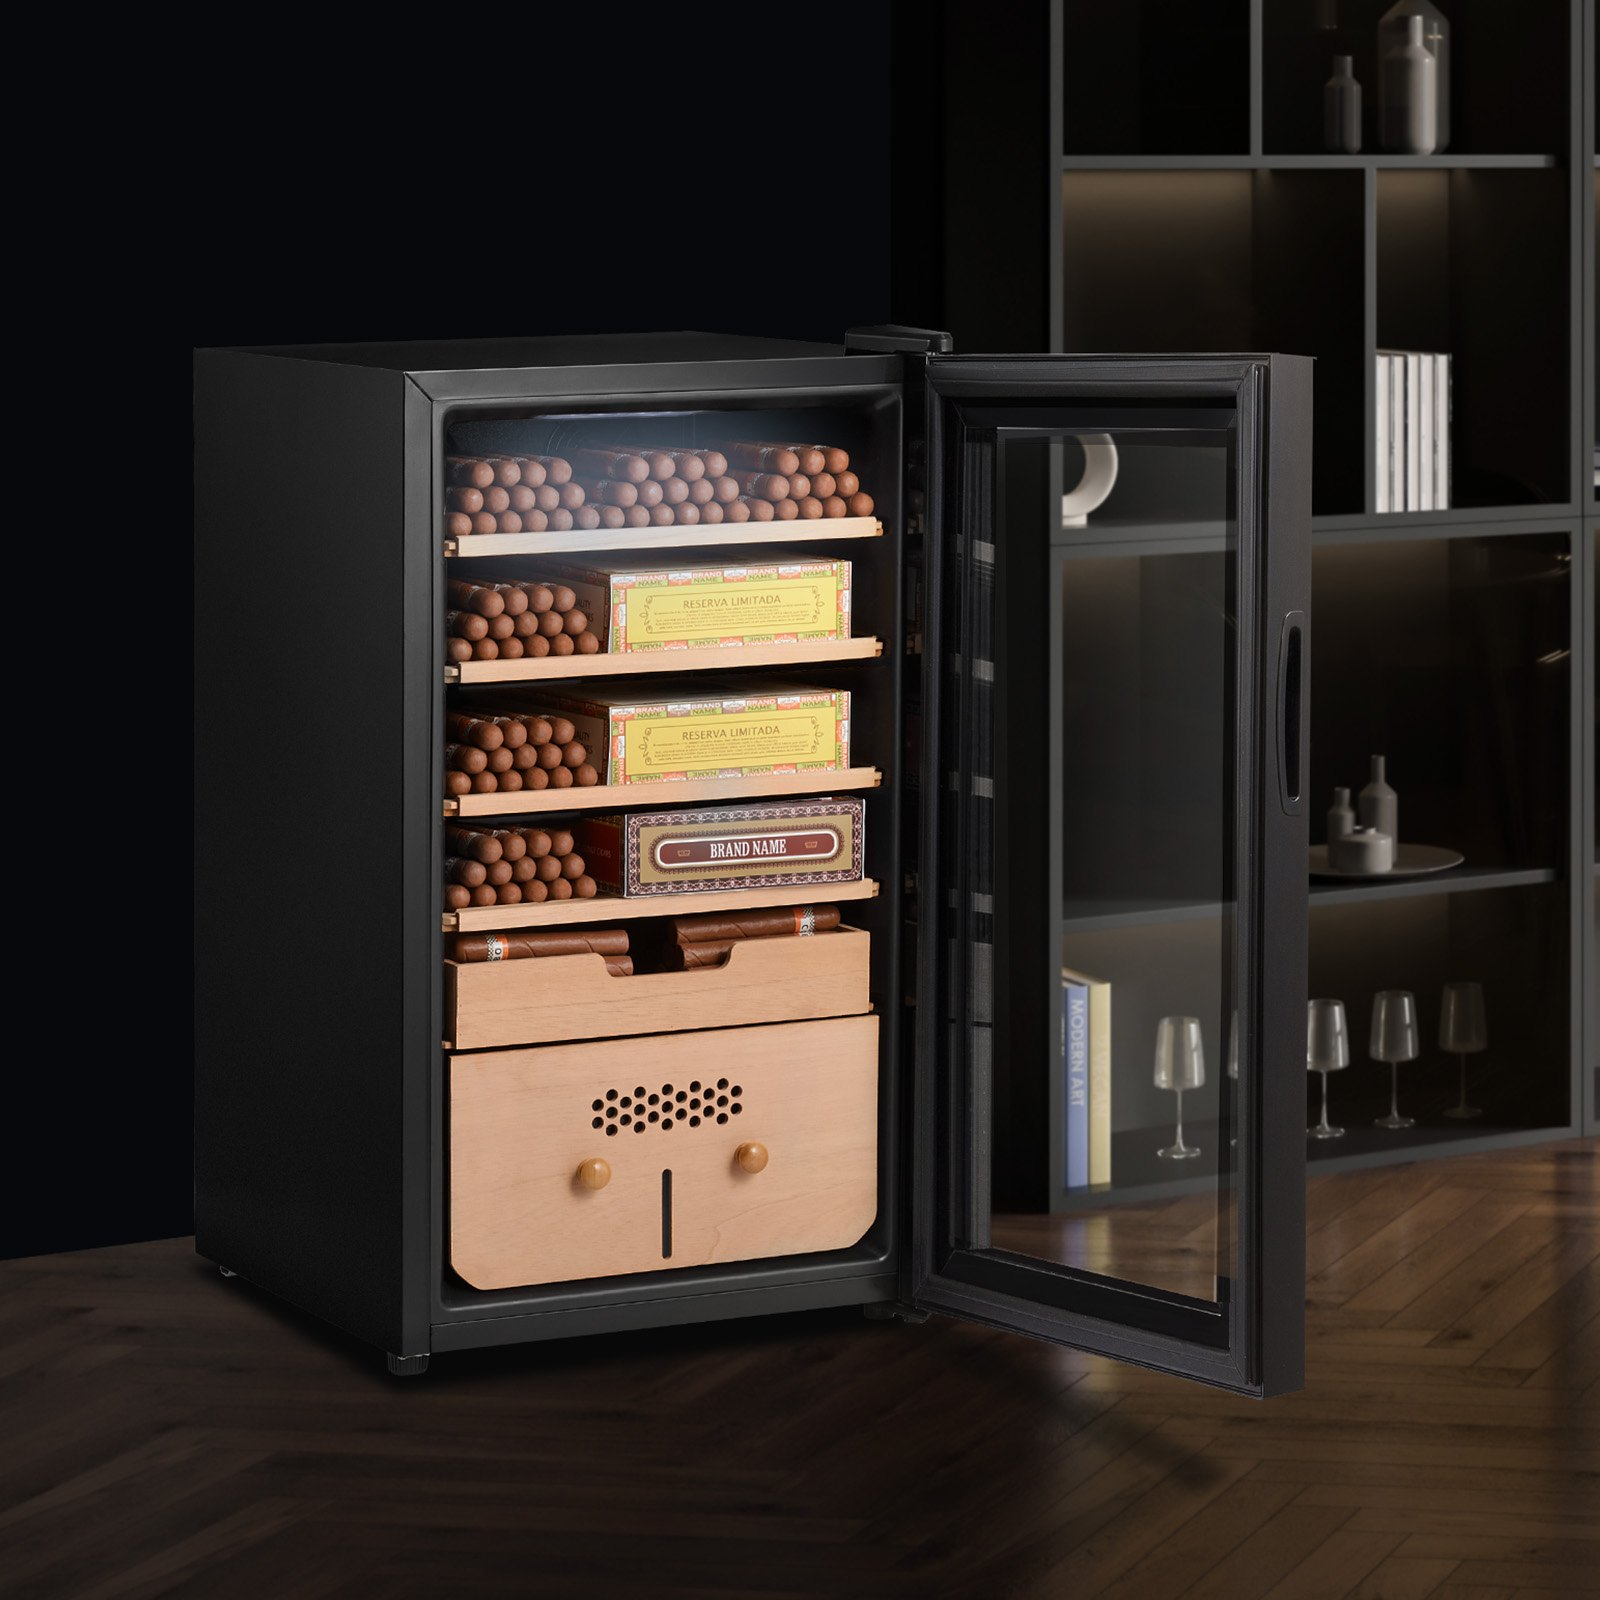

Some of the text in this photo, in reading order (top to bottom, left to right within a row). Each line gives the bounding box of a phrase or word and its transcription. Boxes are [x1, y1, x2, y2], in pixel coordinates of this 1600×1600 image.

[683, 595, 781, 609] RESERVA LIMITADA
[682, 726, 780, 740] RESERVA LIMITADA
[710, 839, 787, 858] BRAND NAME
[1070, 999, 1085, 1107] MODERN ART
